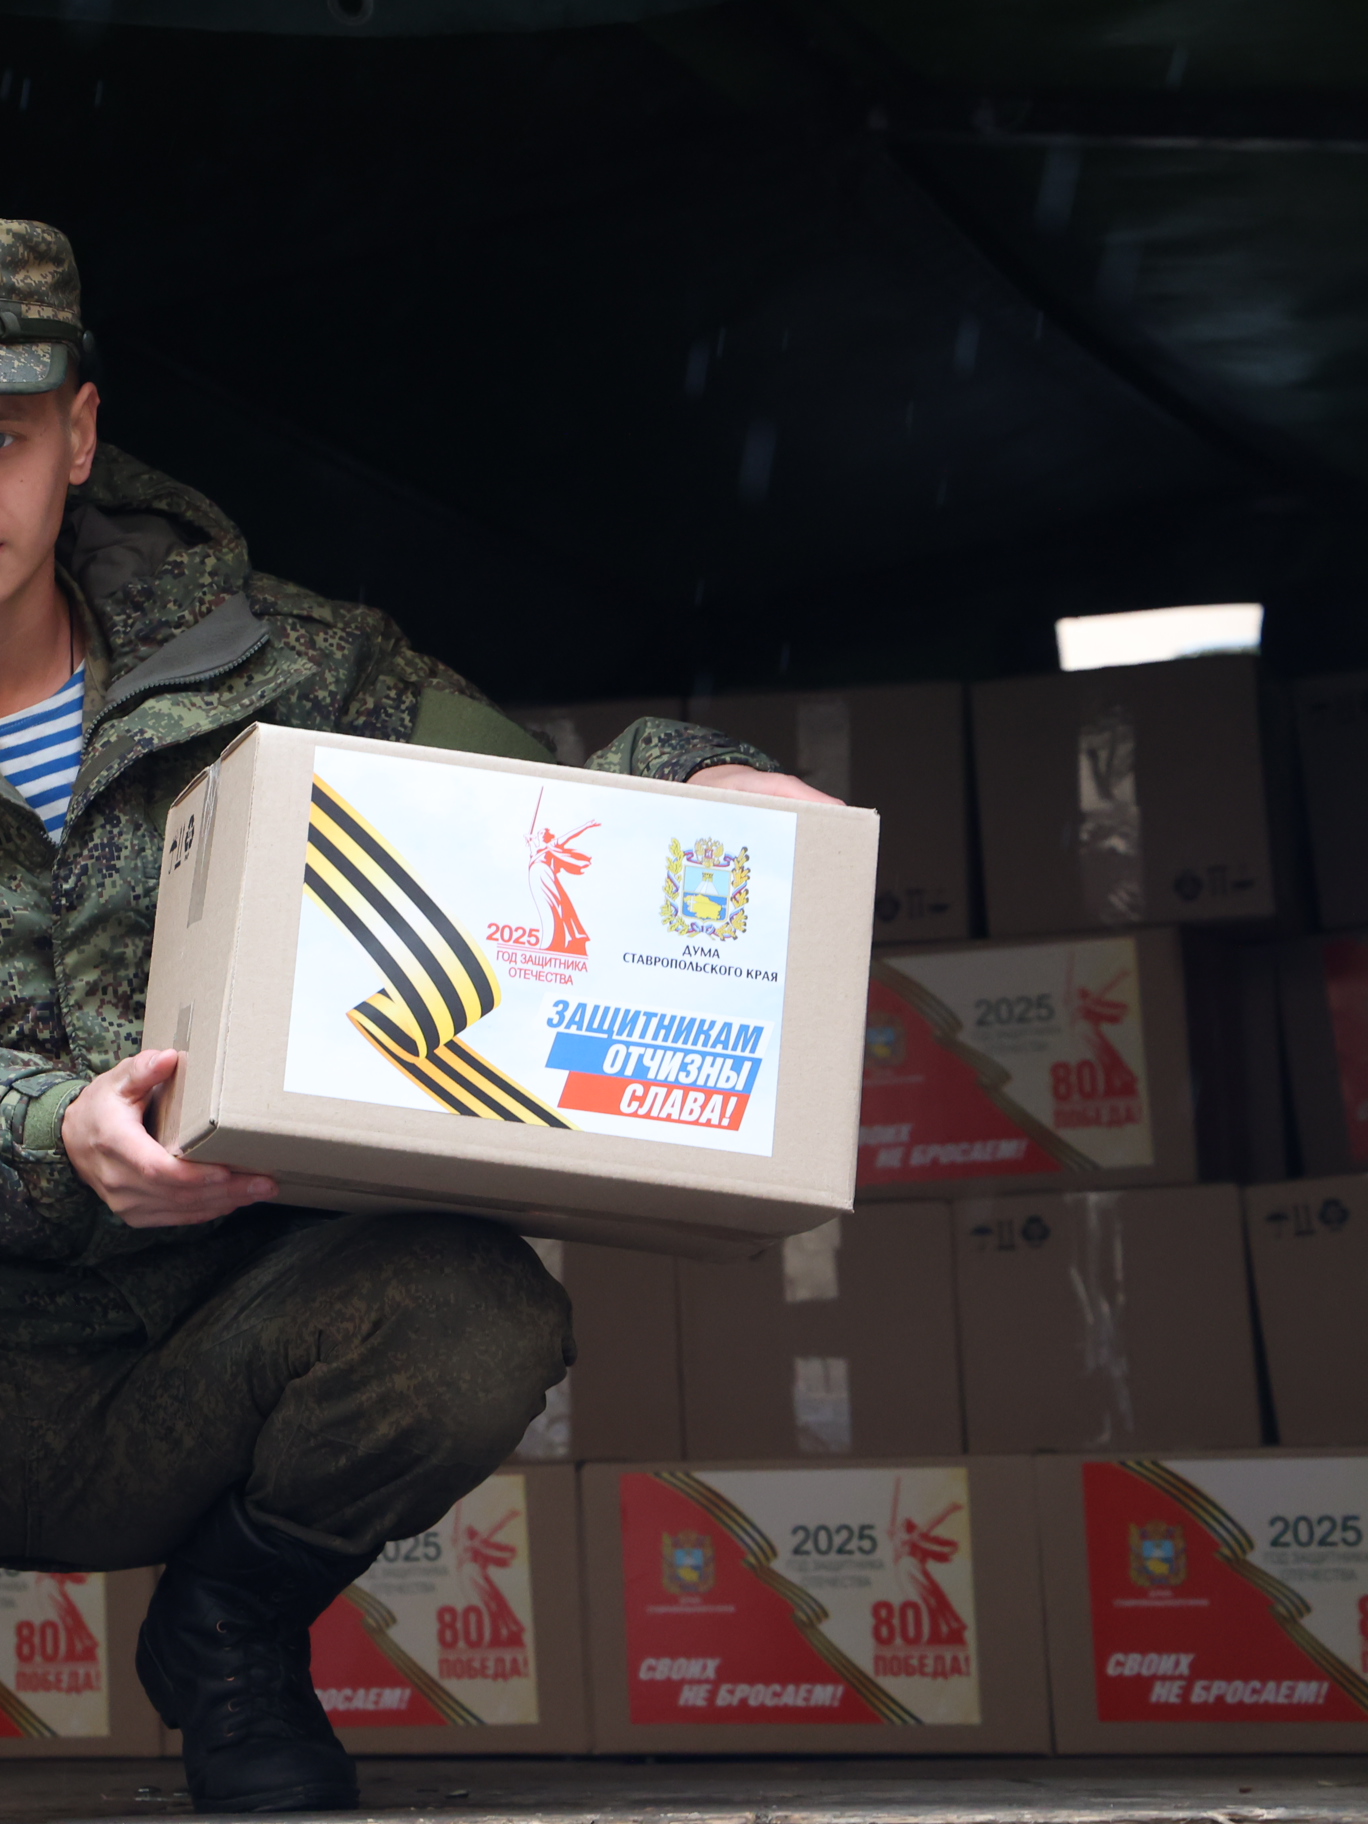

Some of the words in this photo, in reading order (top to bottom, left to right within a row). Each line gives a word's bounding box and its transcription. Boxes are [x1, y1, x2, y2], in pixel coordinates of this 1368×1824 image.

[486, 923, 540, 947] 2025
[496, 950, 518, 964] ГОД
[520, 953, 588, 973] ЗАЩИТНИКА
[622, 952, 743, 978] СТАВРОПОЛЬСКОГО
[746, 969, 778, 982] КРАЯ
[682, 945, 720, 959] ДУМА
[508, 966, 574, 985] ОТЕЧЕСТВА
[975, 993, 1055, 1026] 2025
[546, 999, 765, 1054] ЗАЩИТНИКАМ
[602, 1043, 753, 1091] ОТЧИЗНЫ
[1051, 1059, 1097, 1101] 80
[619, 1083, 738, 1127] СЛАВА!
[791, 1524, 878, 1556] 2025
[1268, 1515, 1363, 1548] 2025
[374, 1532, 442, 1562] 025
[436, 1604, 485, 1649] 80
[871, 1600, 923, 1646] 80
[15, 1620, 61, 1663] 80
[439, 1656, 530, 1681] ПОБЕДА!
[638, 1657, 722, 1681] СВОИХ
[873, 1654, 971, 1679] ПОБЕДА!
[1105, 1653, 1195, 1676] СВОИХ
[15, 1670, 102, 1693] ПОБЕДА!
[677, 1684, 712, 1707] НЕ
[715, 1683, 846, 1707] БРОСАЕМ!
[1148, 1681, 1188, 1704] НЕ
[1190, 1680, 1330, 1704] БРОСАЕМ!
